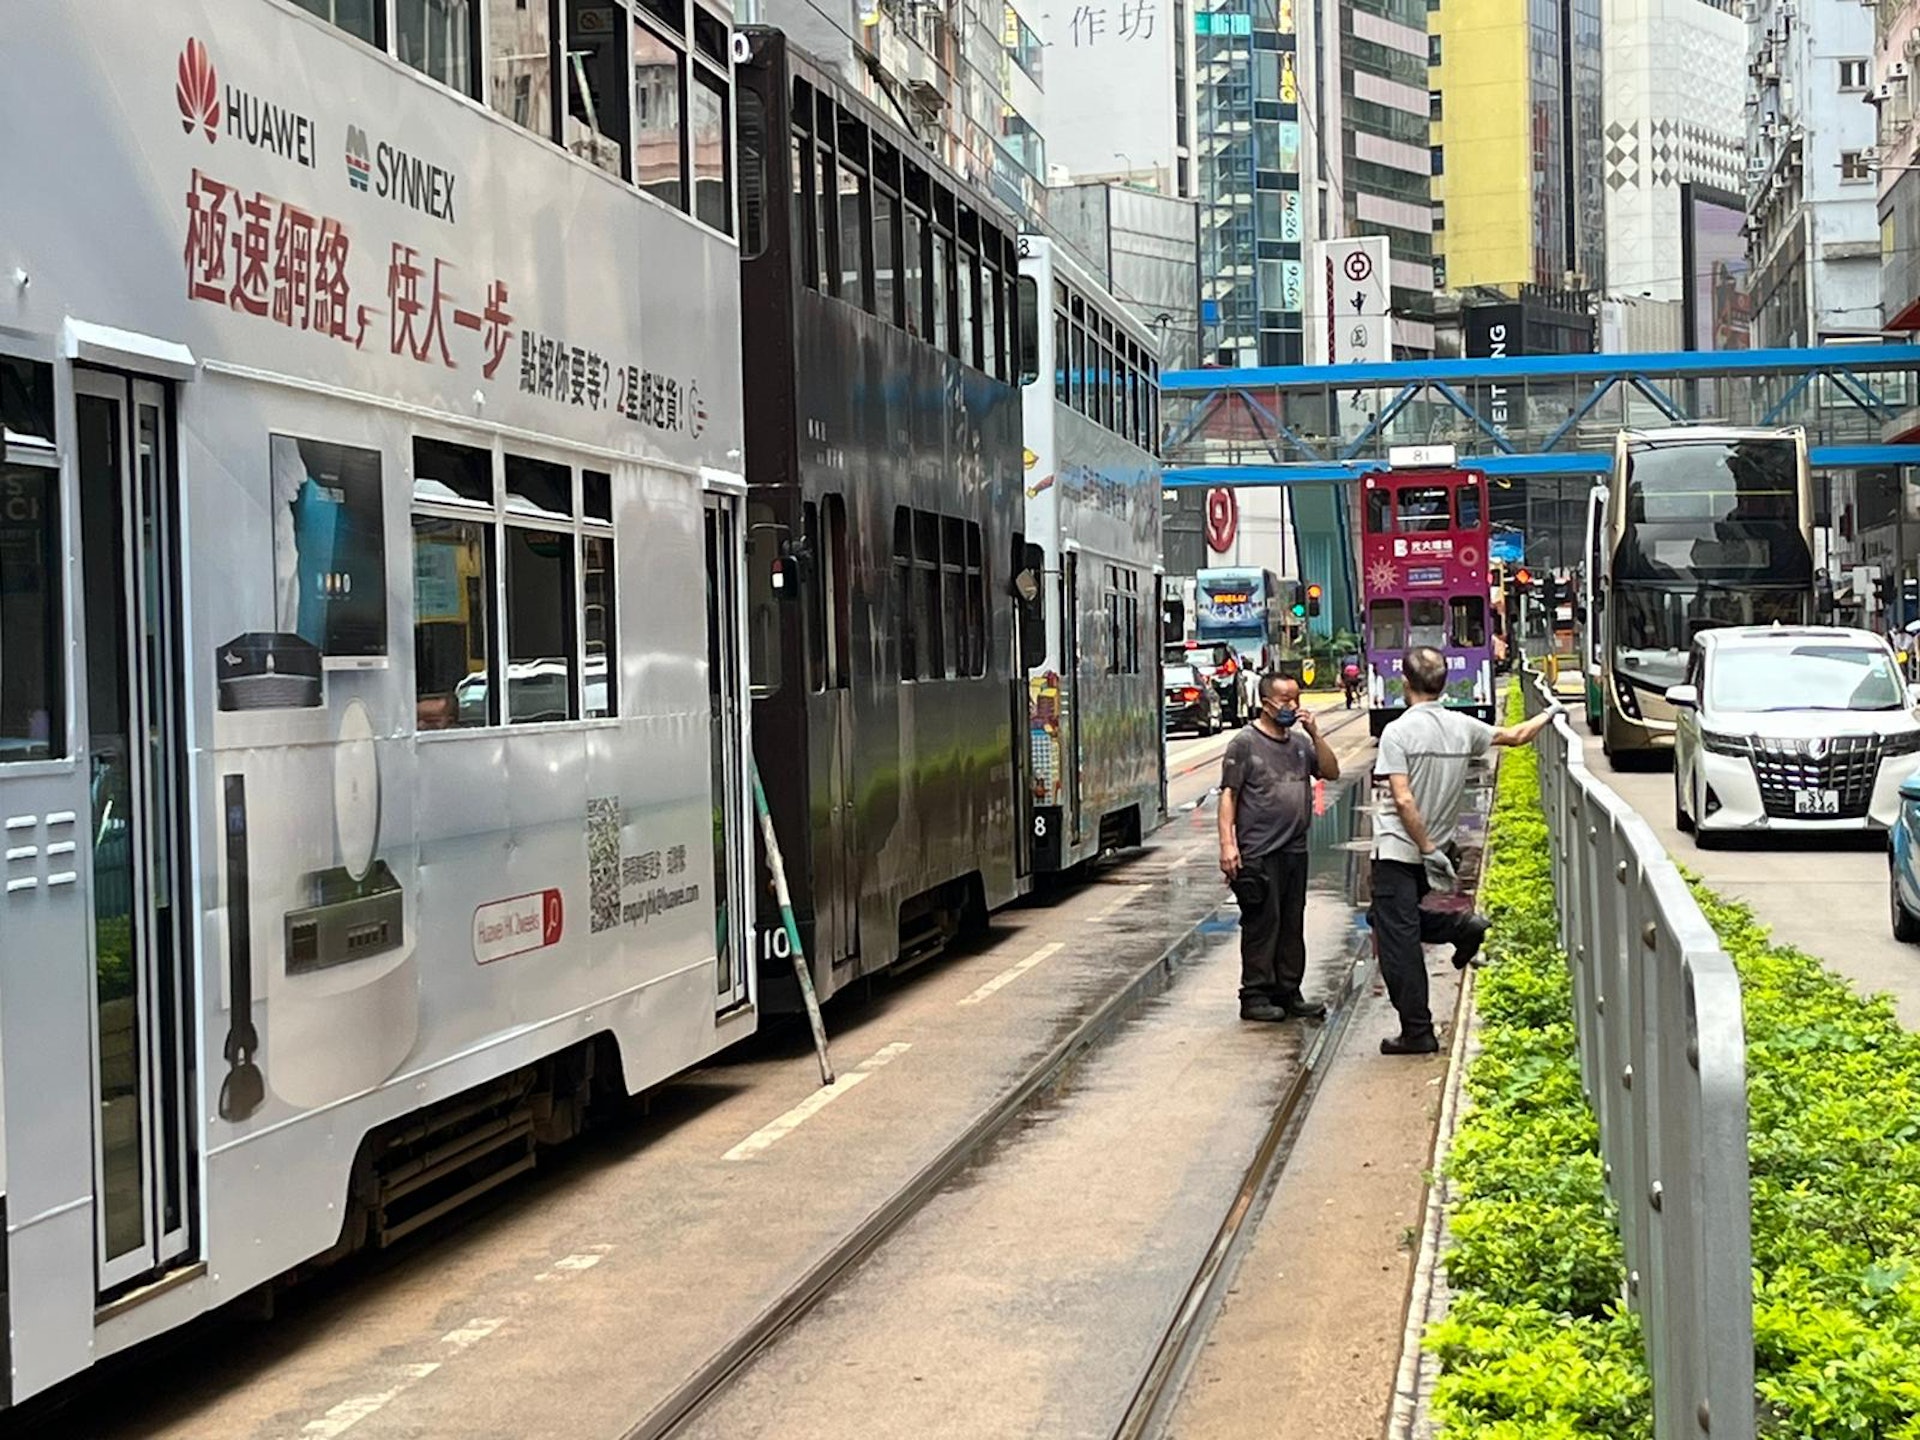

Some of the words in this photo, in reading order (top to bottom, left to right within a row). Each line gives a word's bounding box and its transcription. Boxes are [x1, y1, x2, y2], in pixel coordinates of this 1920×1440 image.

[1043, 0, 1155, 48] 作坊
[226, 84, 316, 169] HUAWEI
[376, 141, 455, 224] SYNNEX
[1034, 815, 1047, 836] 8
[764, 927, 790, 960] 10
